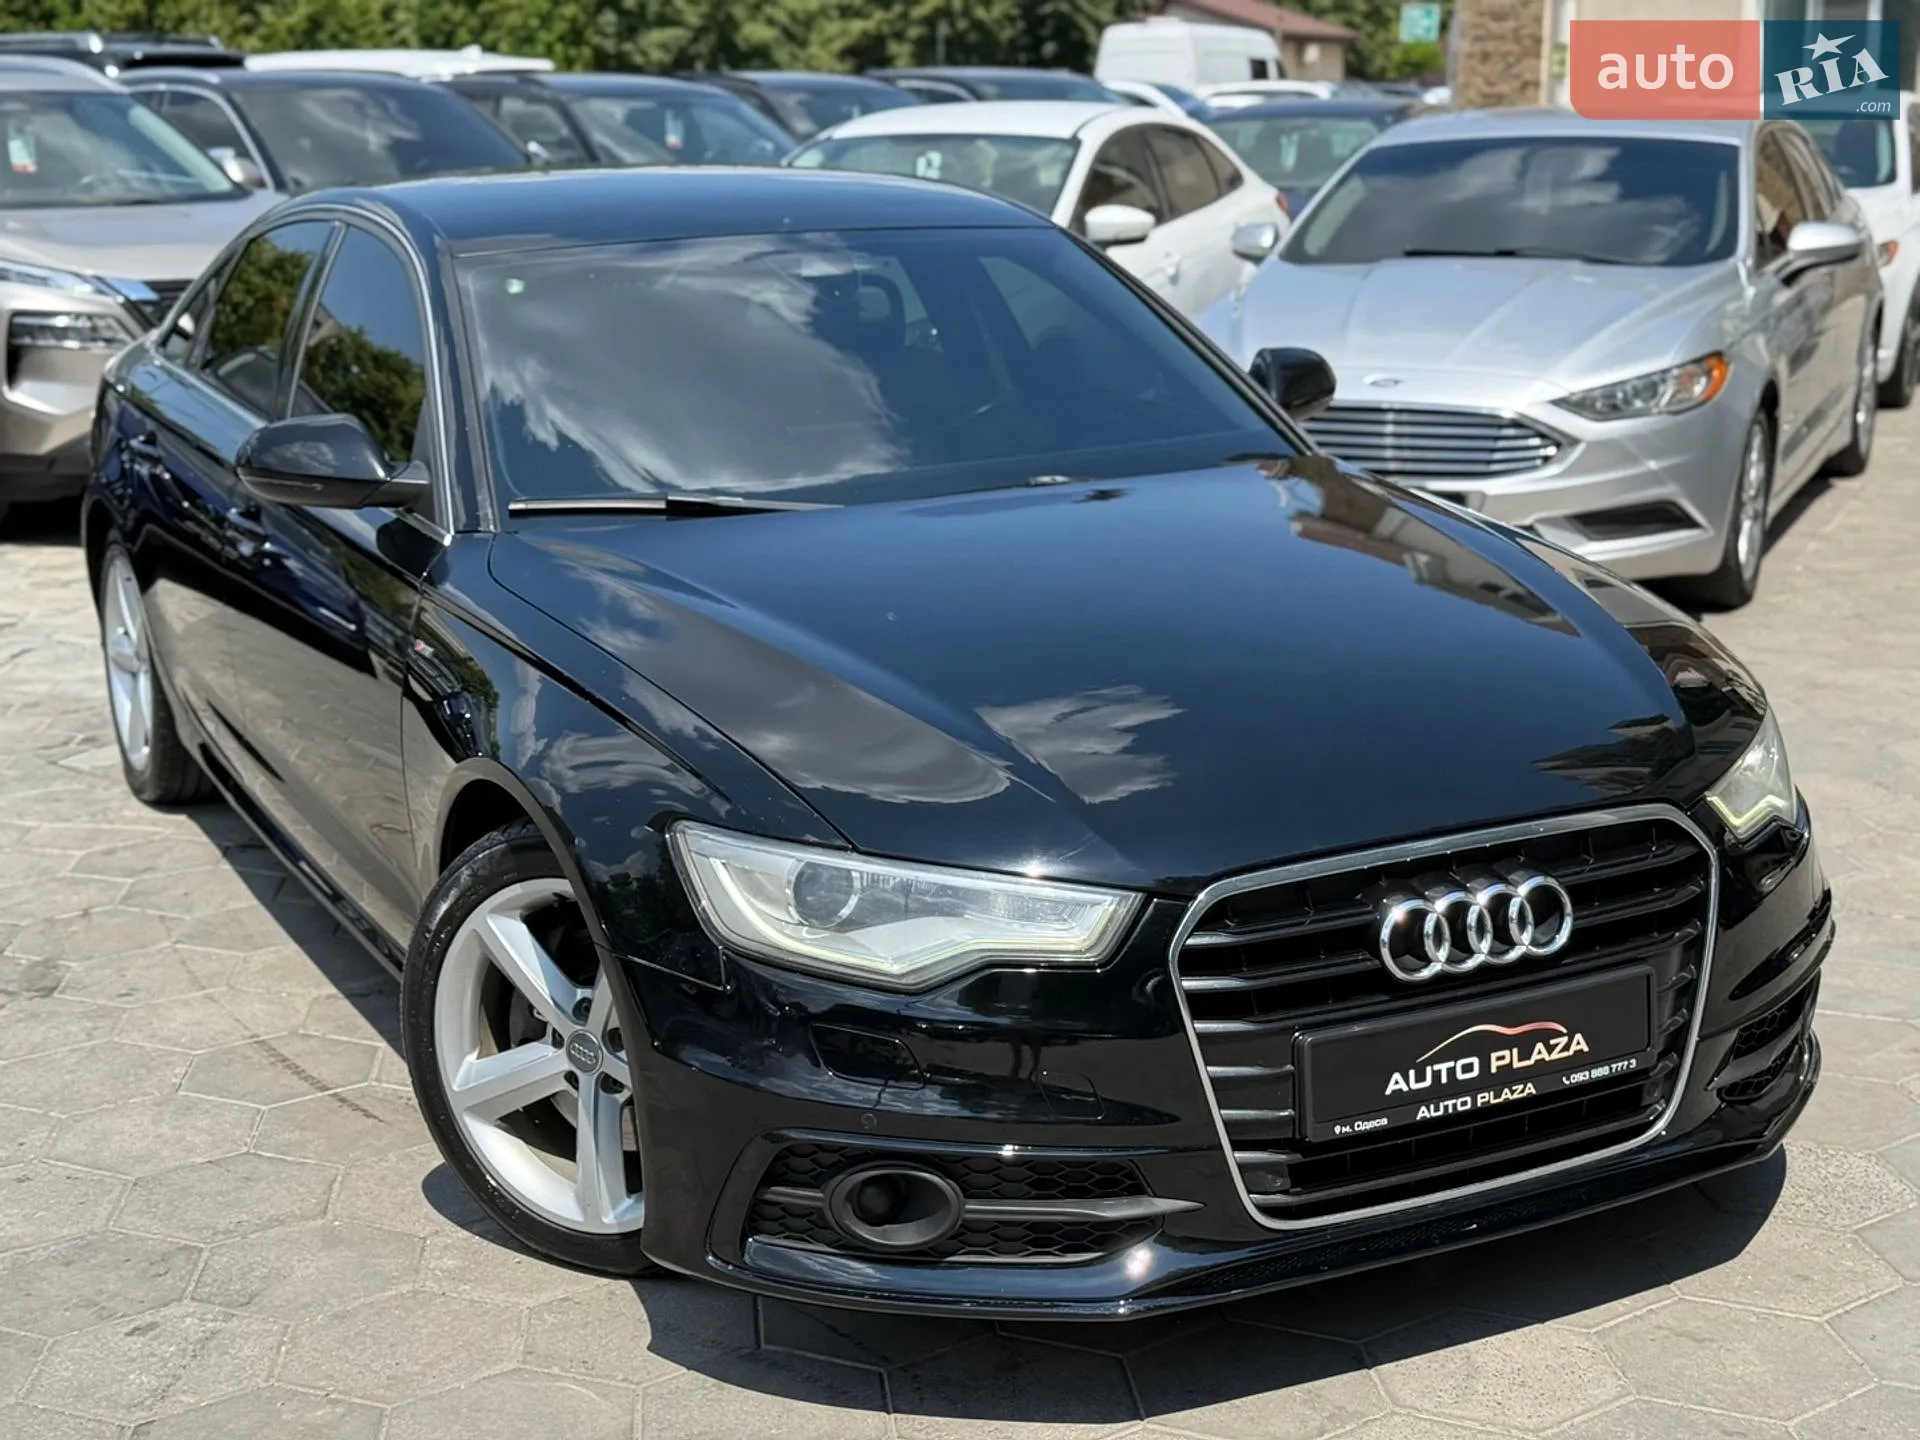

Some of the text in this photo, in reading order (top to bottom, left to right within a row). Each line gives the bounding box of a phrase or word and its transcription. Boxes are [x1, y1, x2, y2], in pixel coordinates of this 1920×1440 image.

[1385, 1033, 1589, 1096] AUTO PLAZA
[1610, 1061, 1628, 1073] 777
[1416, 1082, 1536, 1120] AUTO PLAZA
